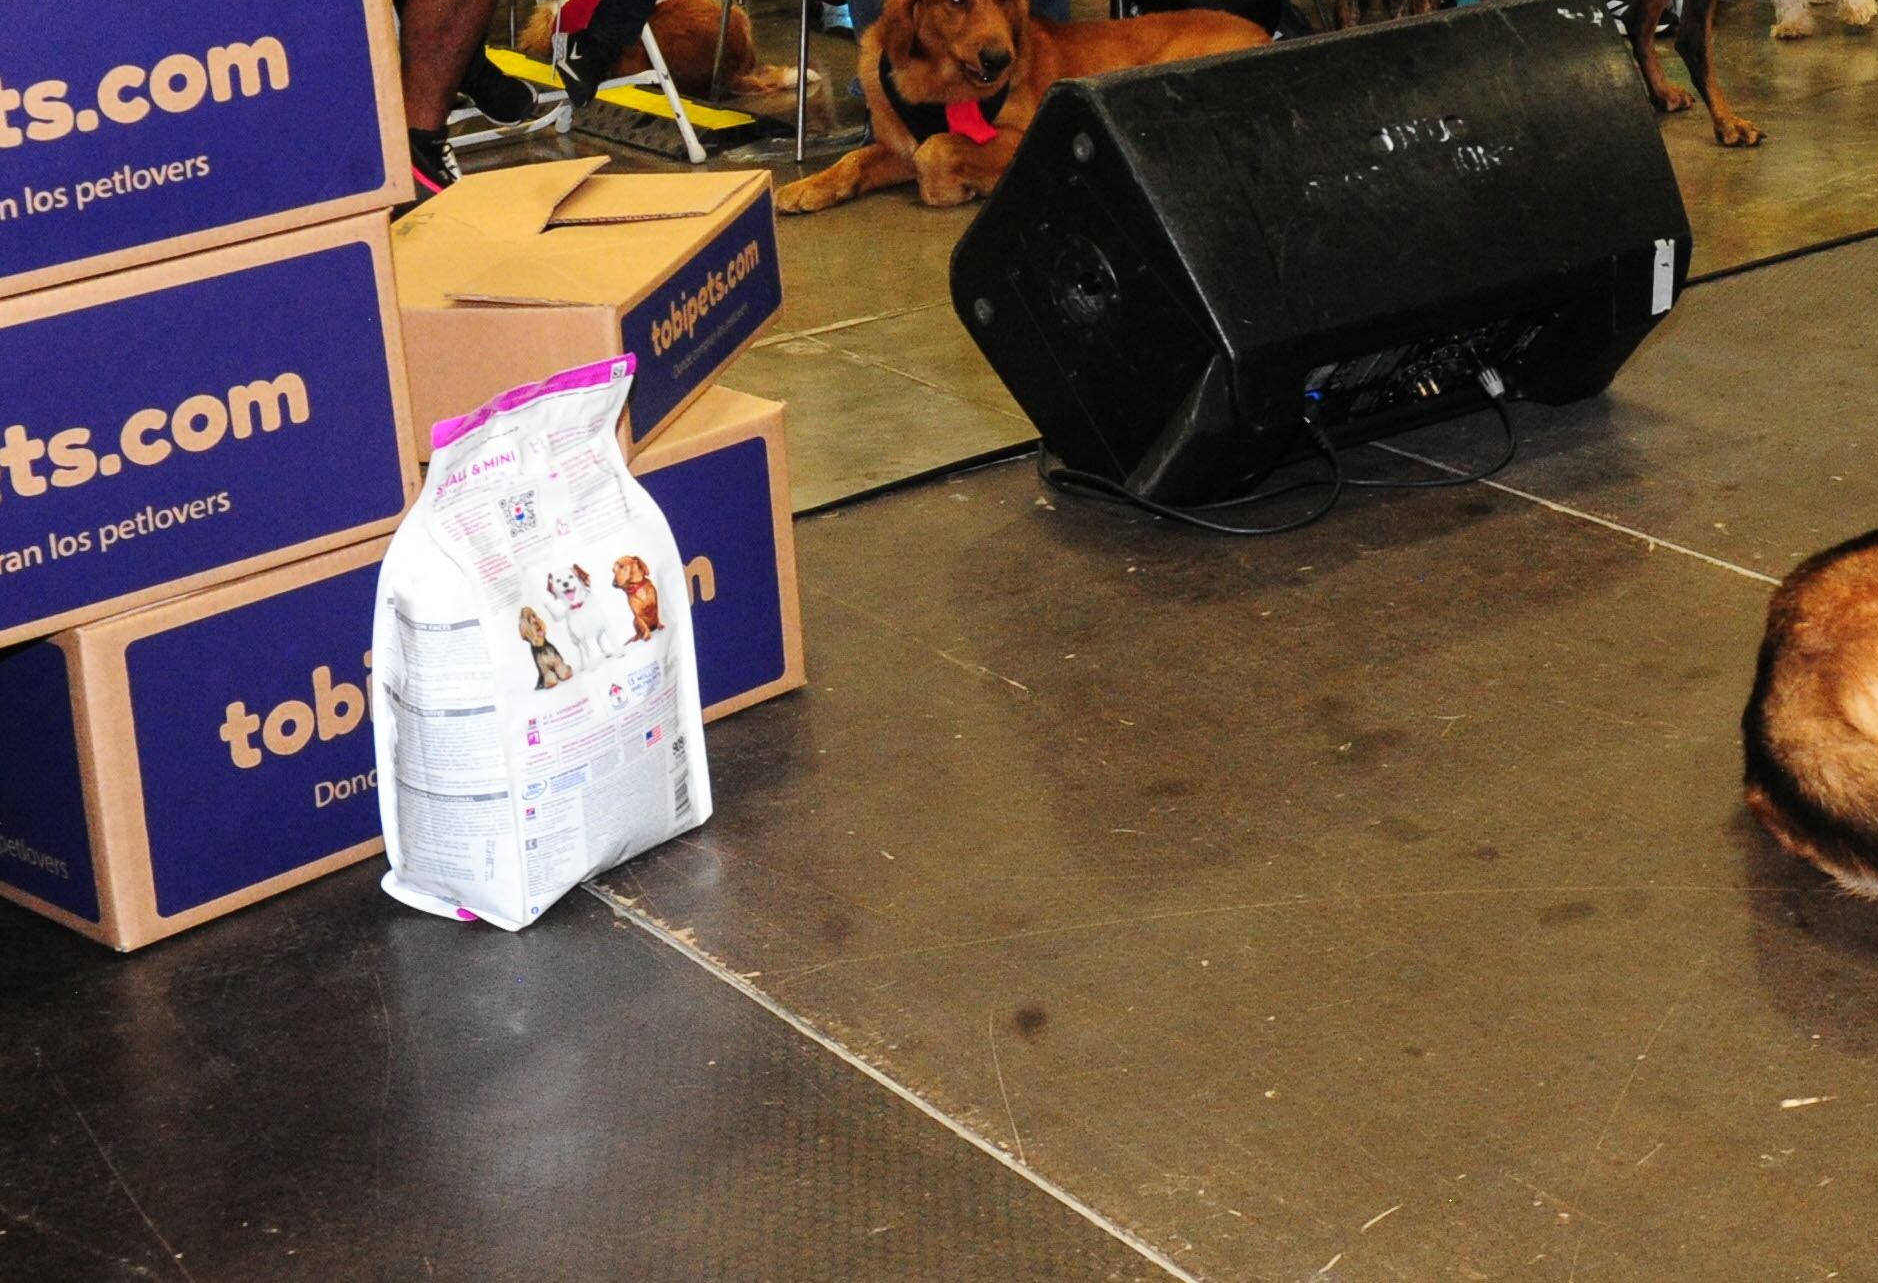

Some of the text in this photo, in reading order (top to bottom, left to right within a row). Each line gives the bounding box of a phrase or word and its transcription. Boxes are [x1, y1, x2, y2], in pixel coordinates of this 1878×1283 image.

[24, 186, 69, 215] los
[76, 155, 210, 211] petlovers
[651, 239, 760, 357] tobipets.com
[0, 371, 311, 497] ts.com
[483, 451, 516, 472] MINI
[48, 530, 92, 560] los
[99, 491, 232, 552] petlovers
